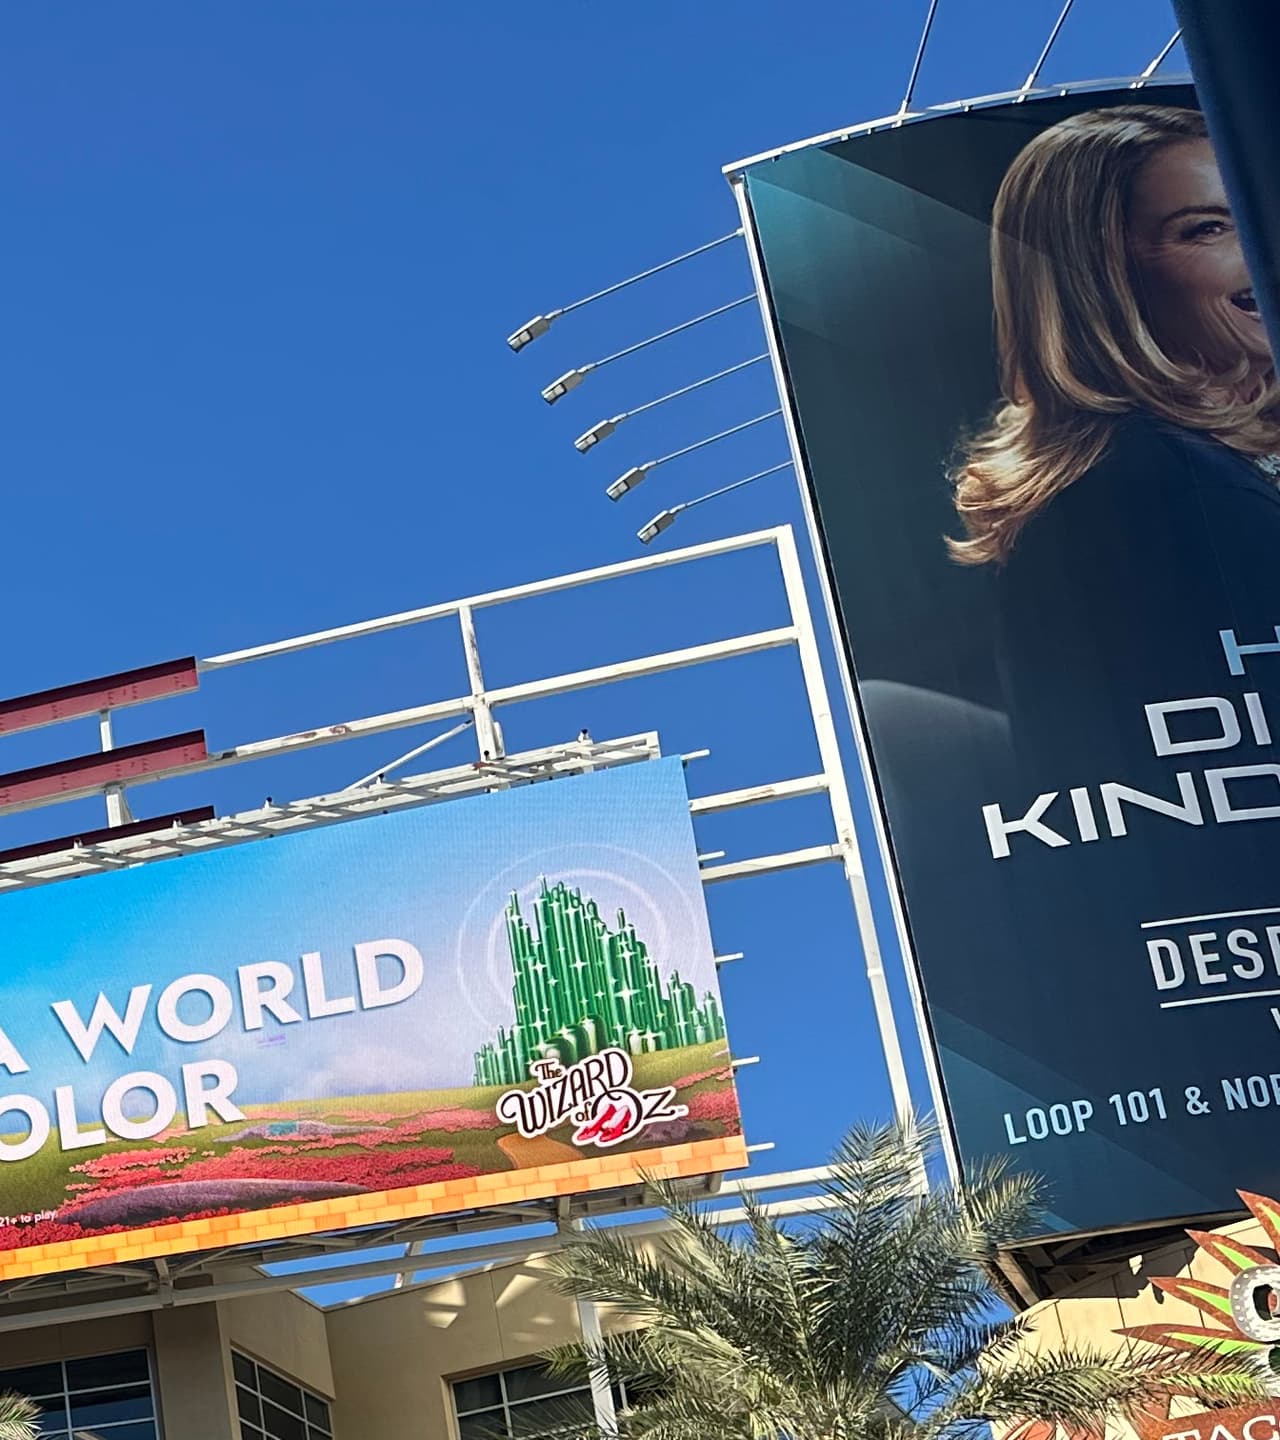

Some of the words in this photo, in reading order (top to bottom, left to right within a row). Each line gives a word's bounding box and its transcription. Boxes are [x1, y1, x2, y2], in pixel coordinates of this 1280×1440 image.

[1144, 692, 1272, 757] DI
[982, 763, 1280, 859] KIND
[50, 938, 425, 1063] WORLD
[500, 1051, 628, 1133] WIZARD
[535, 1062, 563, 1079] The
[575, 1102, 592, 1123] of
[1003, 1099, 1093, 1145] LOOP
[1108, 1087, 1168, 1126] 101
[1185, 1086, 1211, 1115] &
[20, 1214, 31, 1224] to
